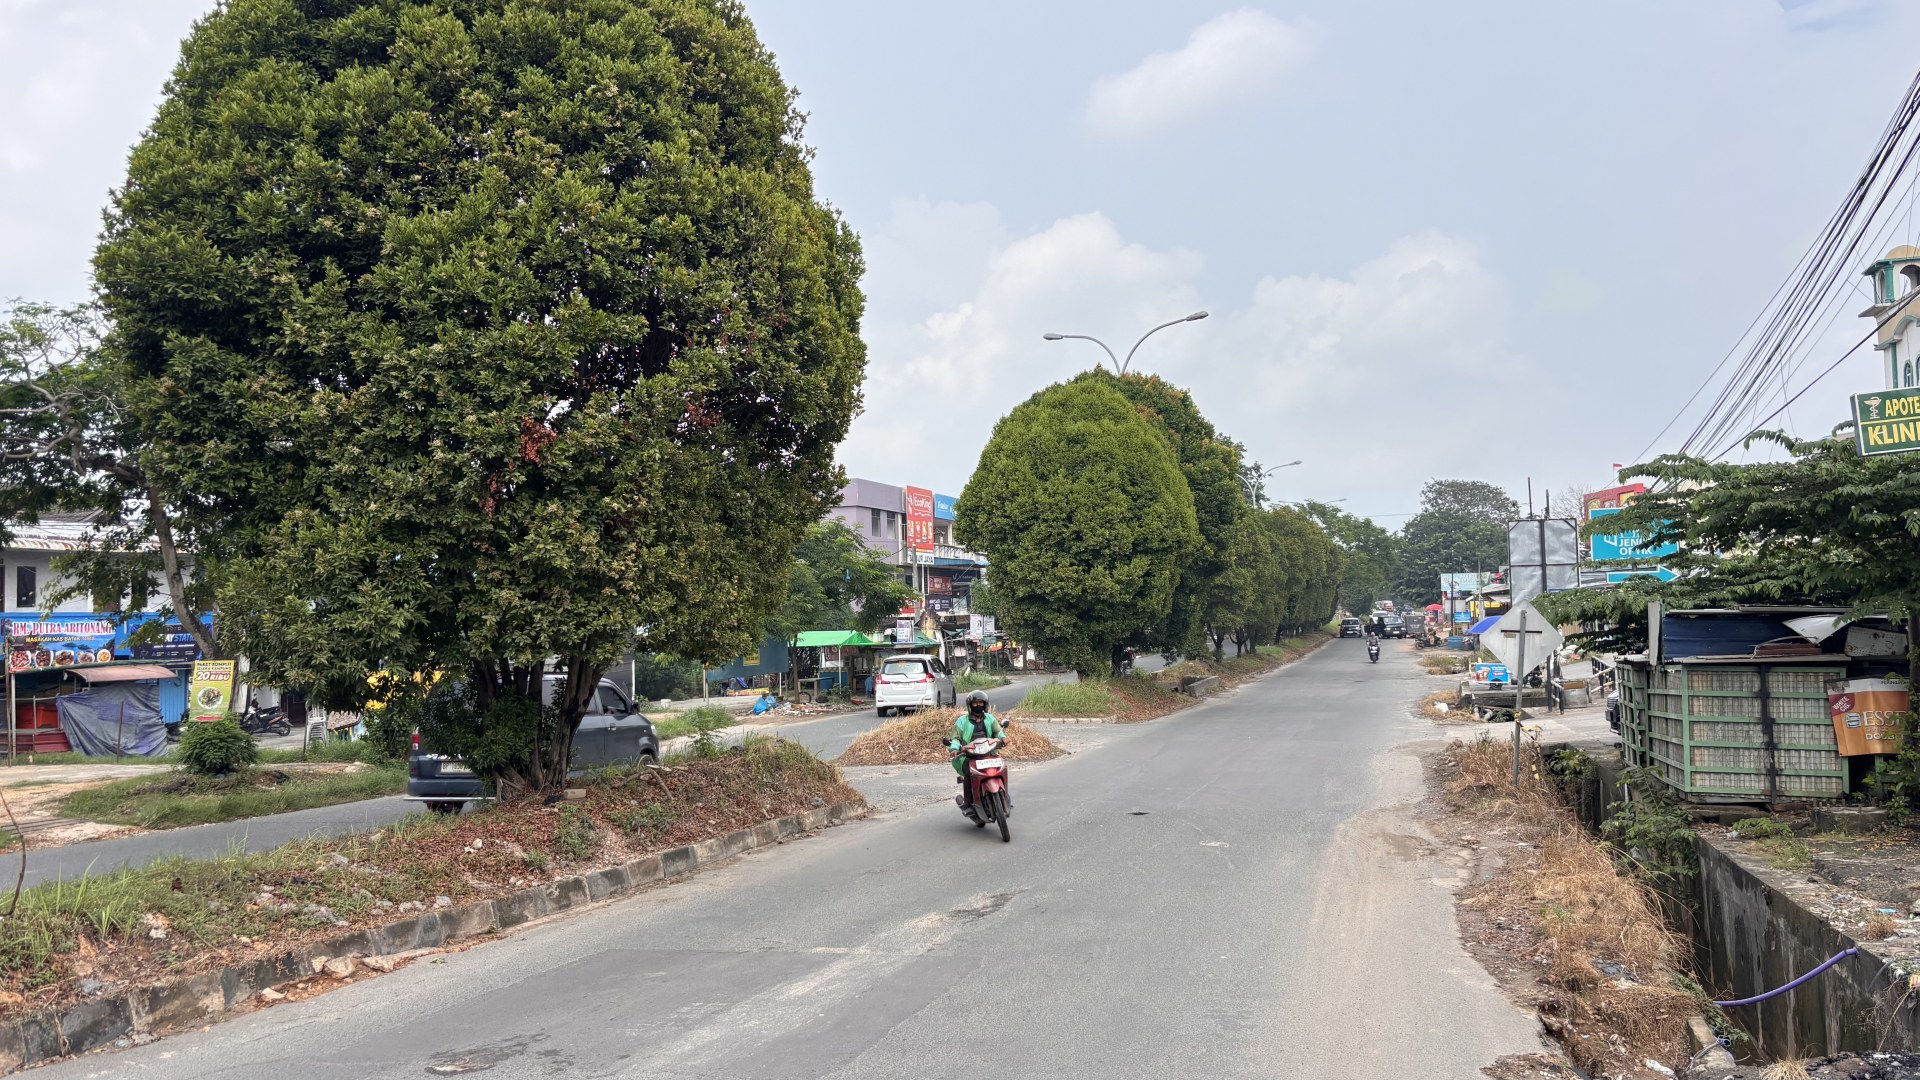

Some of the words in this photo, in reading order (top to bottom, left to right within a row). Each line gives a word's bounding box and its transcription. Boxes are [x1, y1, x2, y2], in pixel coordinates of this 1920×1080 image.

[32, 622, 62, 635] PUTRA
[63, 621, 113, 634] ARITONANG
[195, 671, 210, 680] 20
[1832, 696, 1850, 710] WHITE
